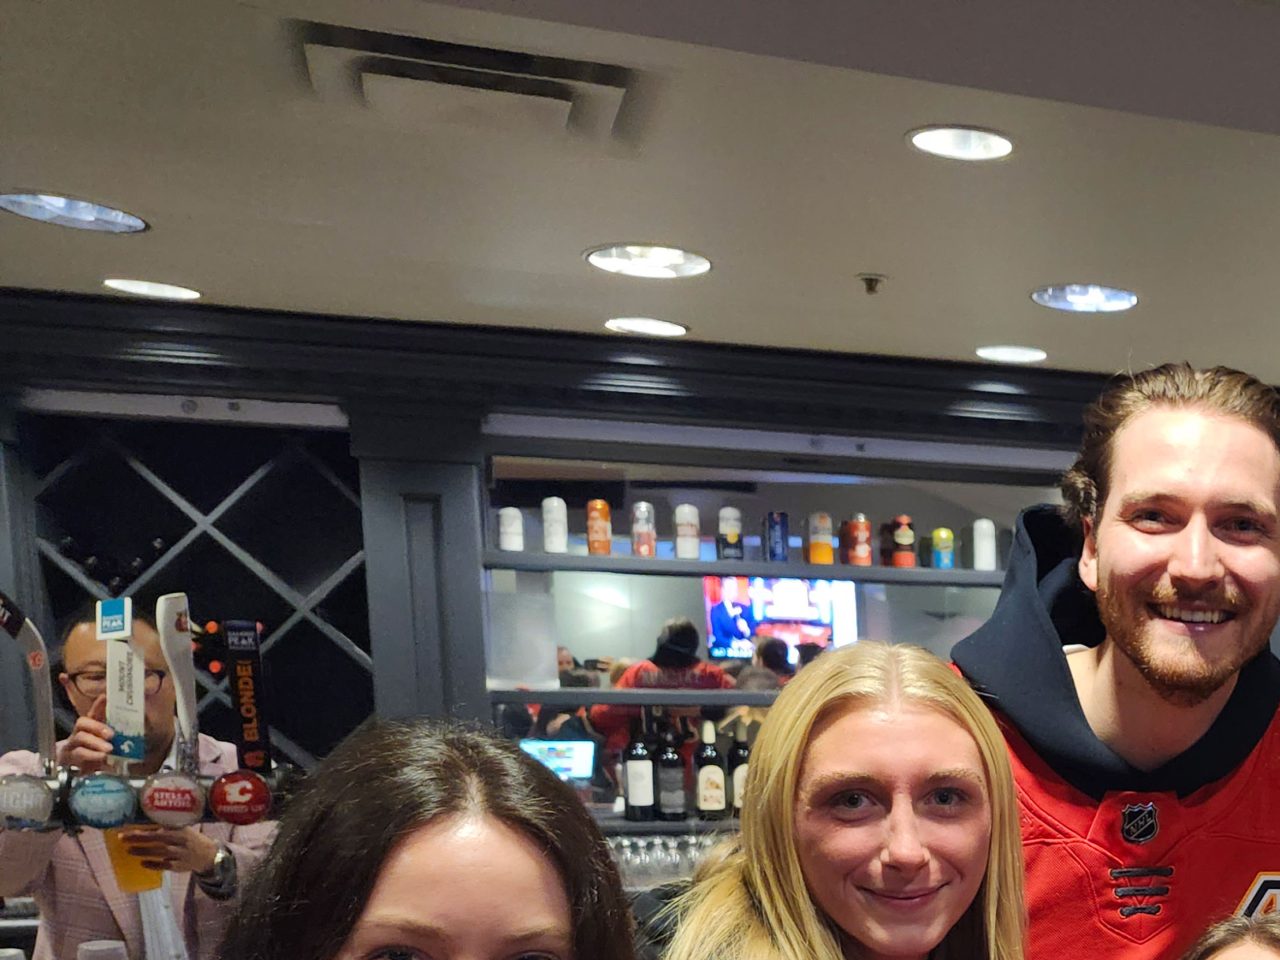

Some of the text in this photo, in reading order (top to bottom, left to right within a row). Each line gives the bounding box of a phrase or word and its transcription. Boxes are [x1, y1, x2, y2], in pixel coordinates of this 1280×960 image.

[235, 662, 260, 742] BLONDE
[153, 790, 192, 801] STELLA
[1129, 813, 1153, 836] NHL
